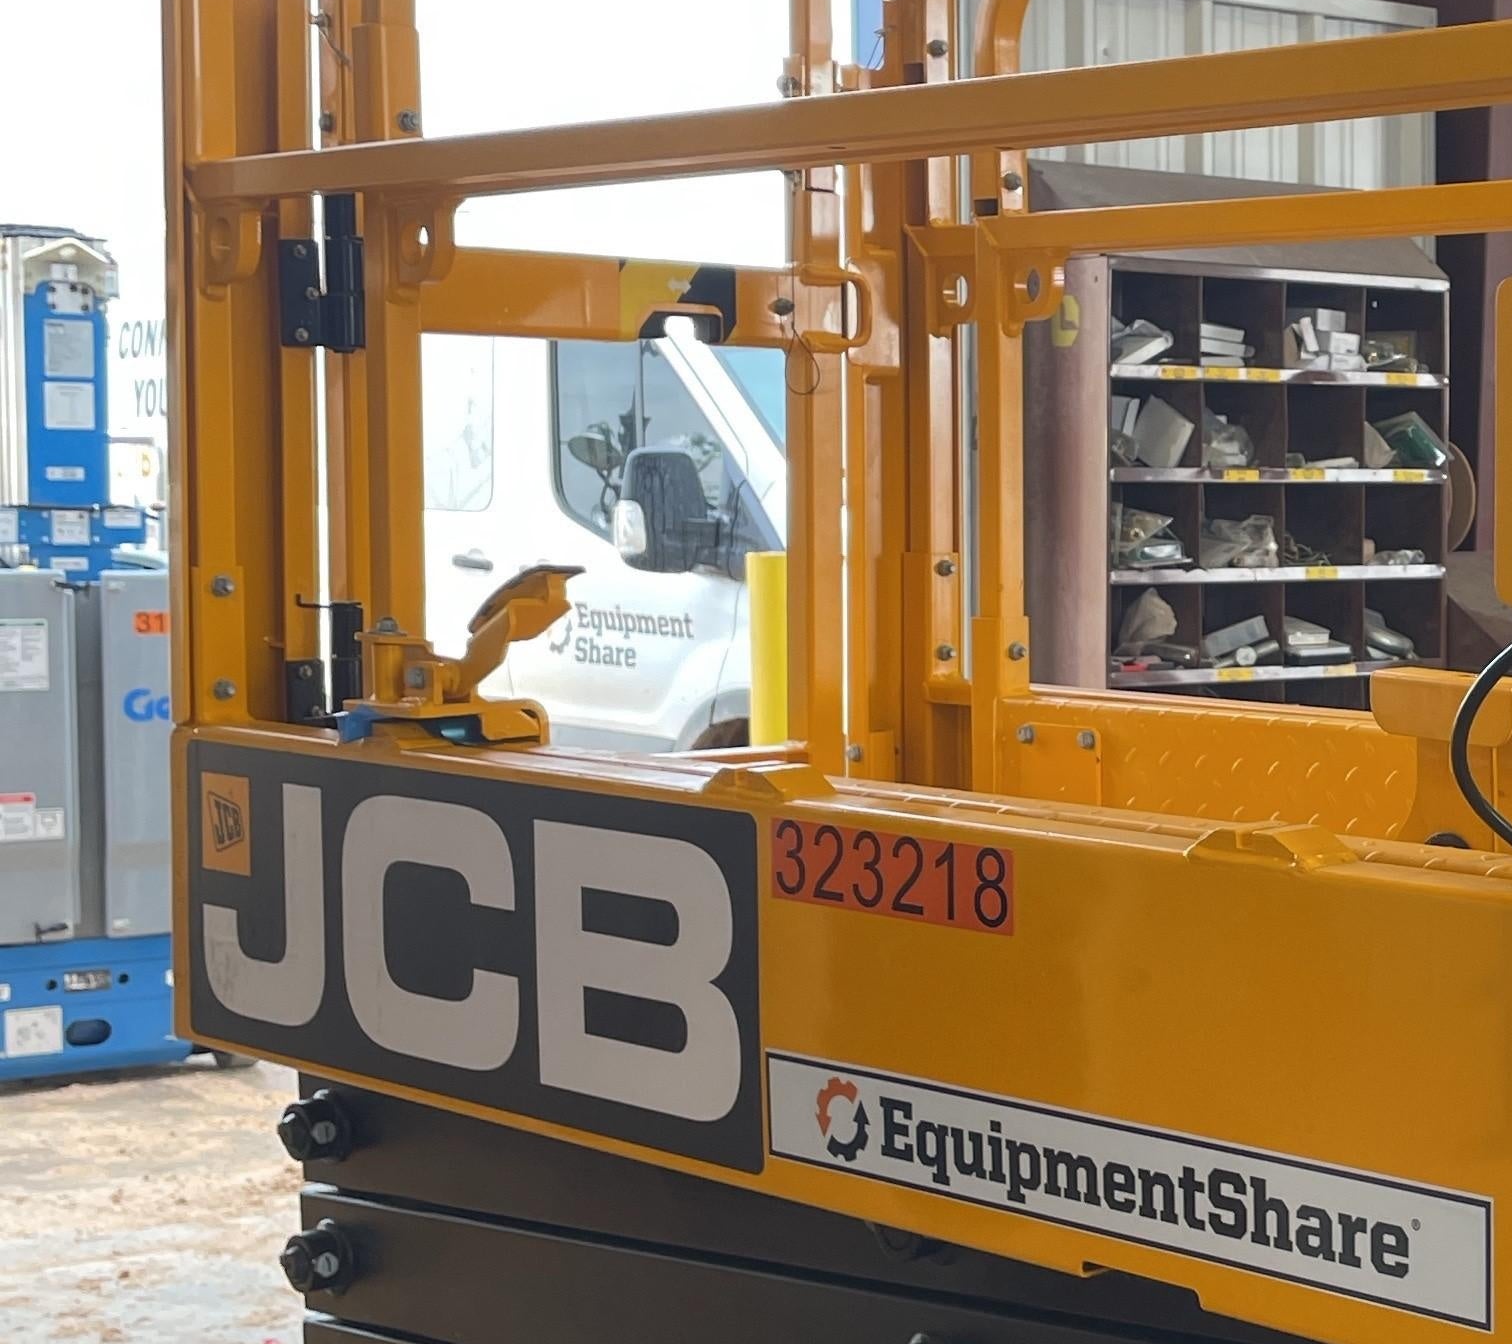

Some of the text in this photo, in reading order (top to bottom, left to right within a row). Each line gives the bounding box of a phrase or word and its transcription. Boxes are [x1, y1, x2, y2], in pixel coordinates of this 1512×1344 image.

[574, 601, 695, 640] Equipment
[574, 636, 638, 670] Share
[775, 819, 1009, 928] 323218
[202, 782, 742, 1123] JCB
